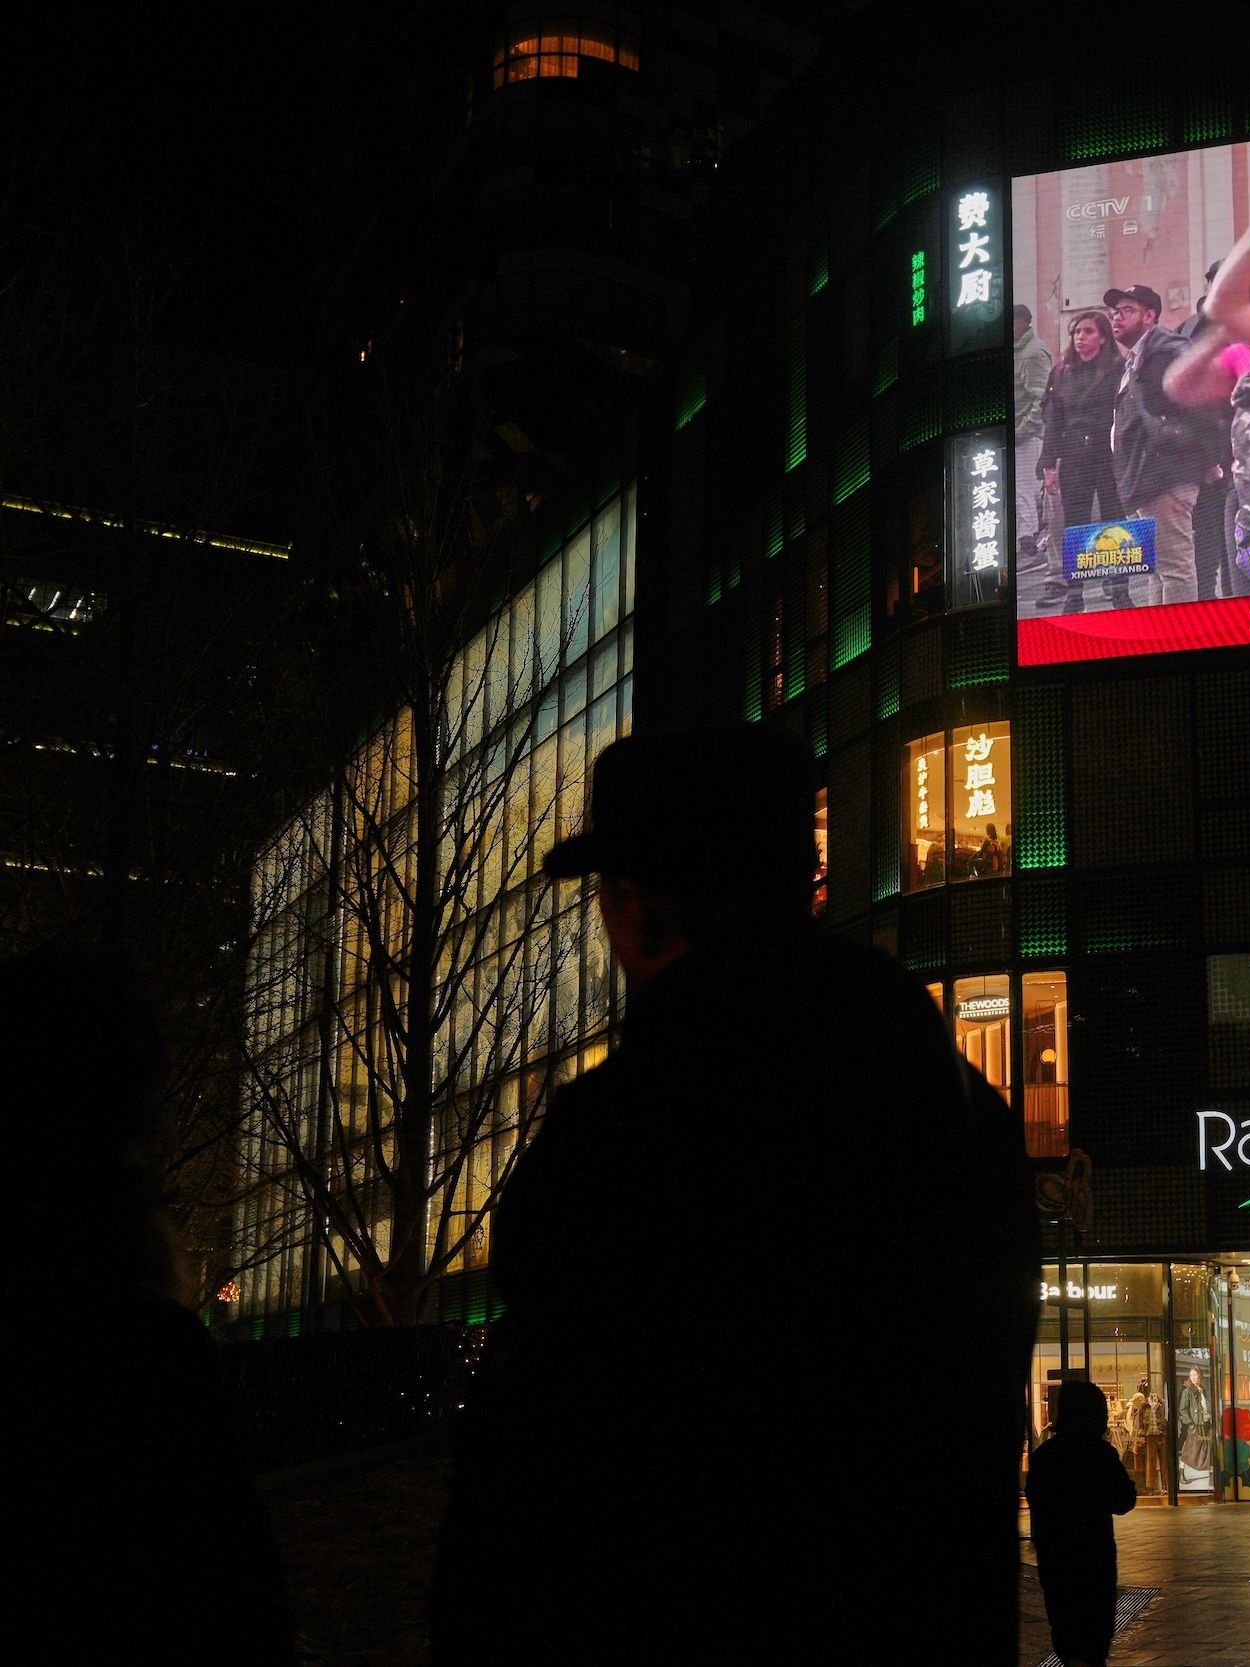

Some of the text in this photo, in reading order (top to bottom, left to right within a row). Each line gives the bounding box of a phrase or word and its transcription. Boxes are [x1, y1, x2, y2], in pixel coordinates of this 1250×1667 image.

[1066, 196, 1130, 220] CCTV
[957, 192, 992, 307] 费大厨
[911, 251, 925, 326] 辣椒炒肉
[1076, 547, 1143, 569] 新闻联播
[1071, 564, 1149, 580] XINWEN LIANBO
[964, 733, 996, 818] 沙胆彪
[1040, 1281, 1117, 1300] Babour.
